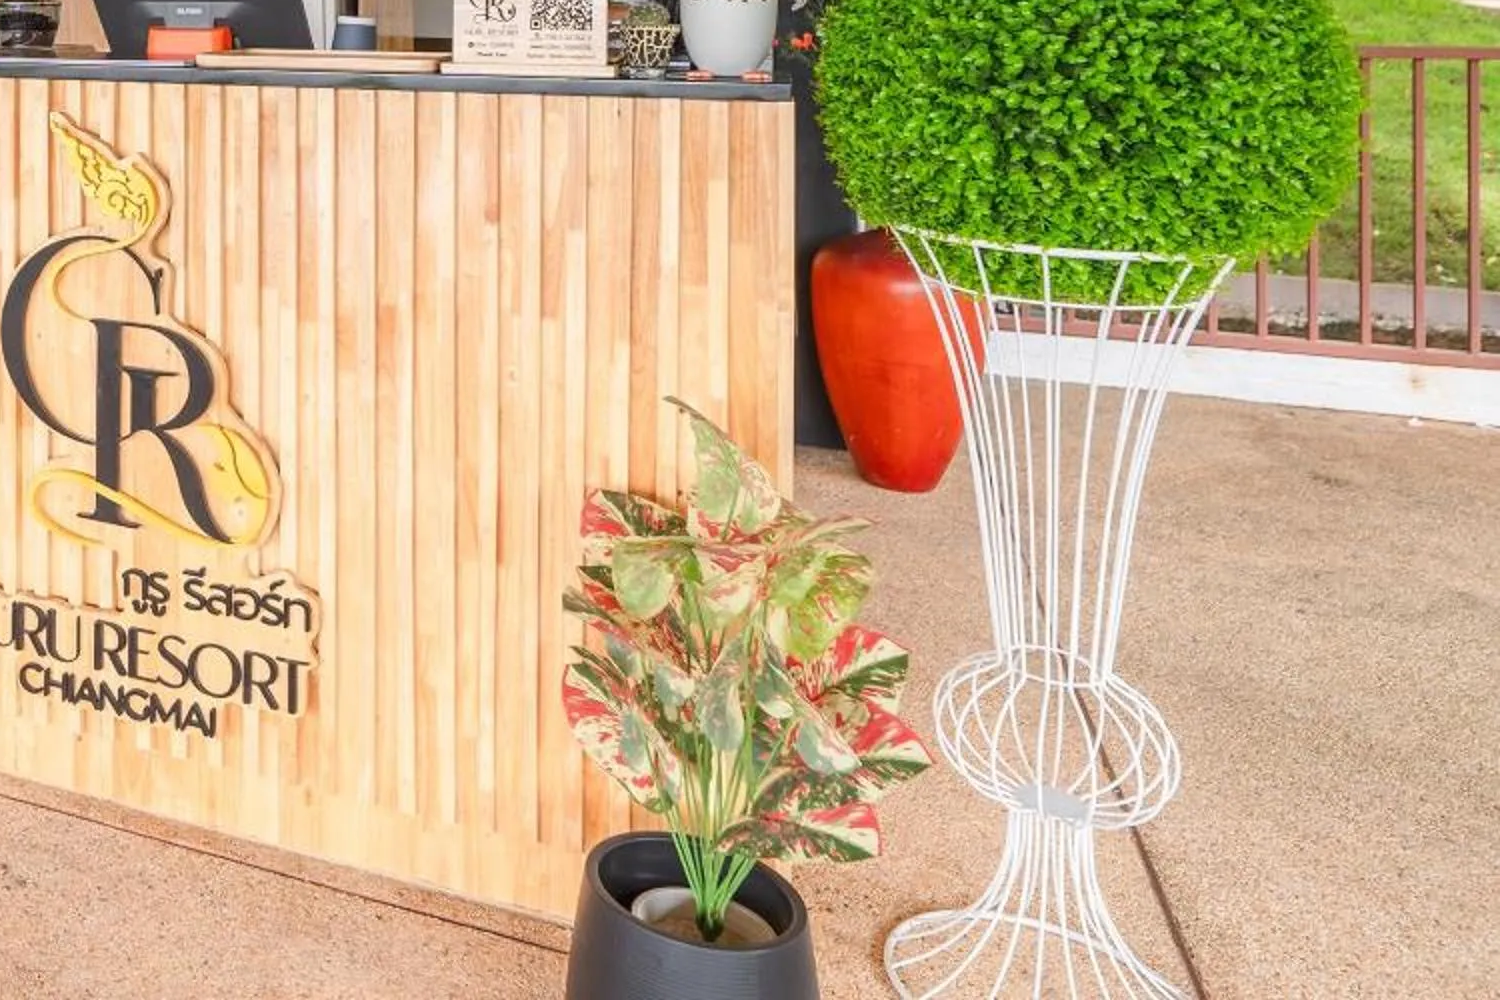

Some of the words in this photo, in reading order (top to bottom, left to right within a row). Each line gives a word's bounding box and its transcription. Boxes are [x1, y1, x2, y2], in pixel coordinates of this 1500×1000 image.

[121, 567, 171, 617] กูรู
[181, 566, 313, 633] รีสอร์ท
[18, 662, 217, 739] CHIANGMAI
[92, 618, 310, 715] RESORT
